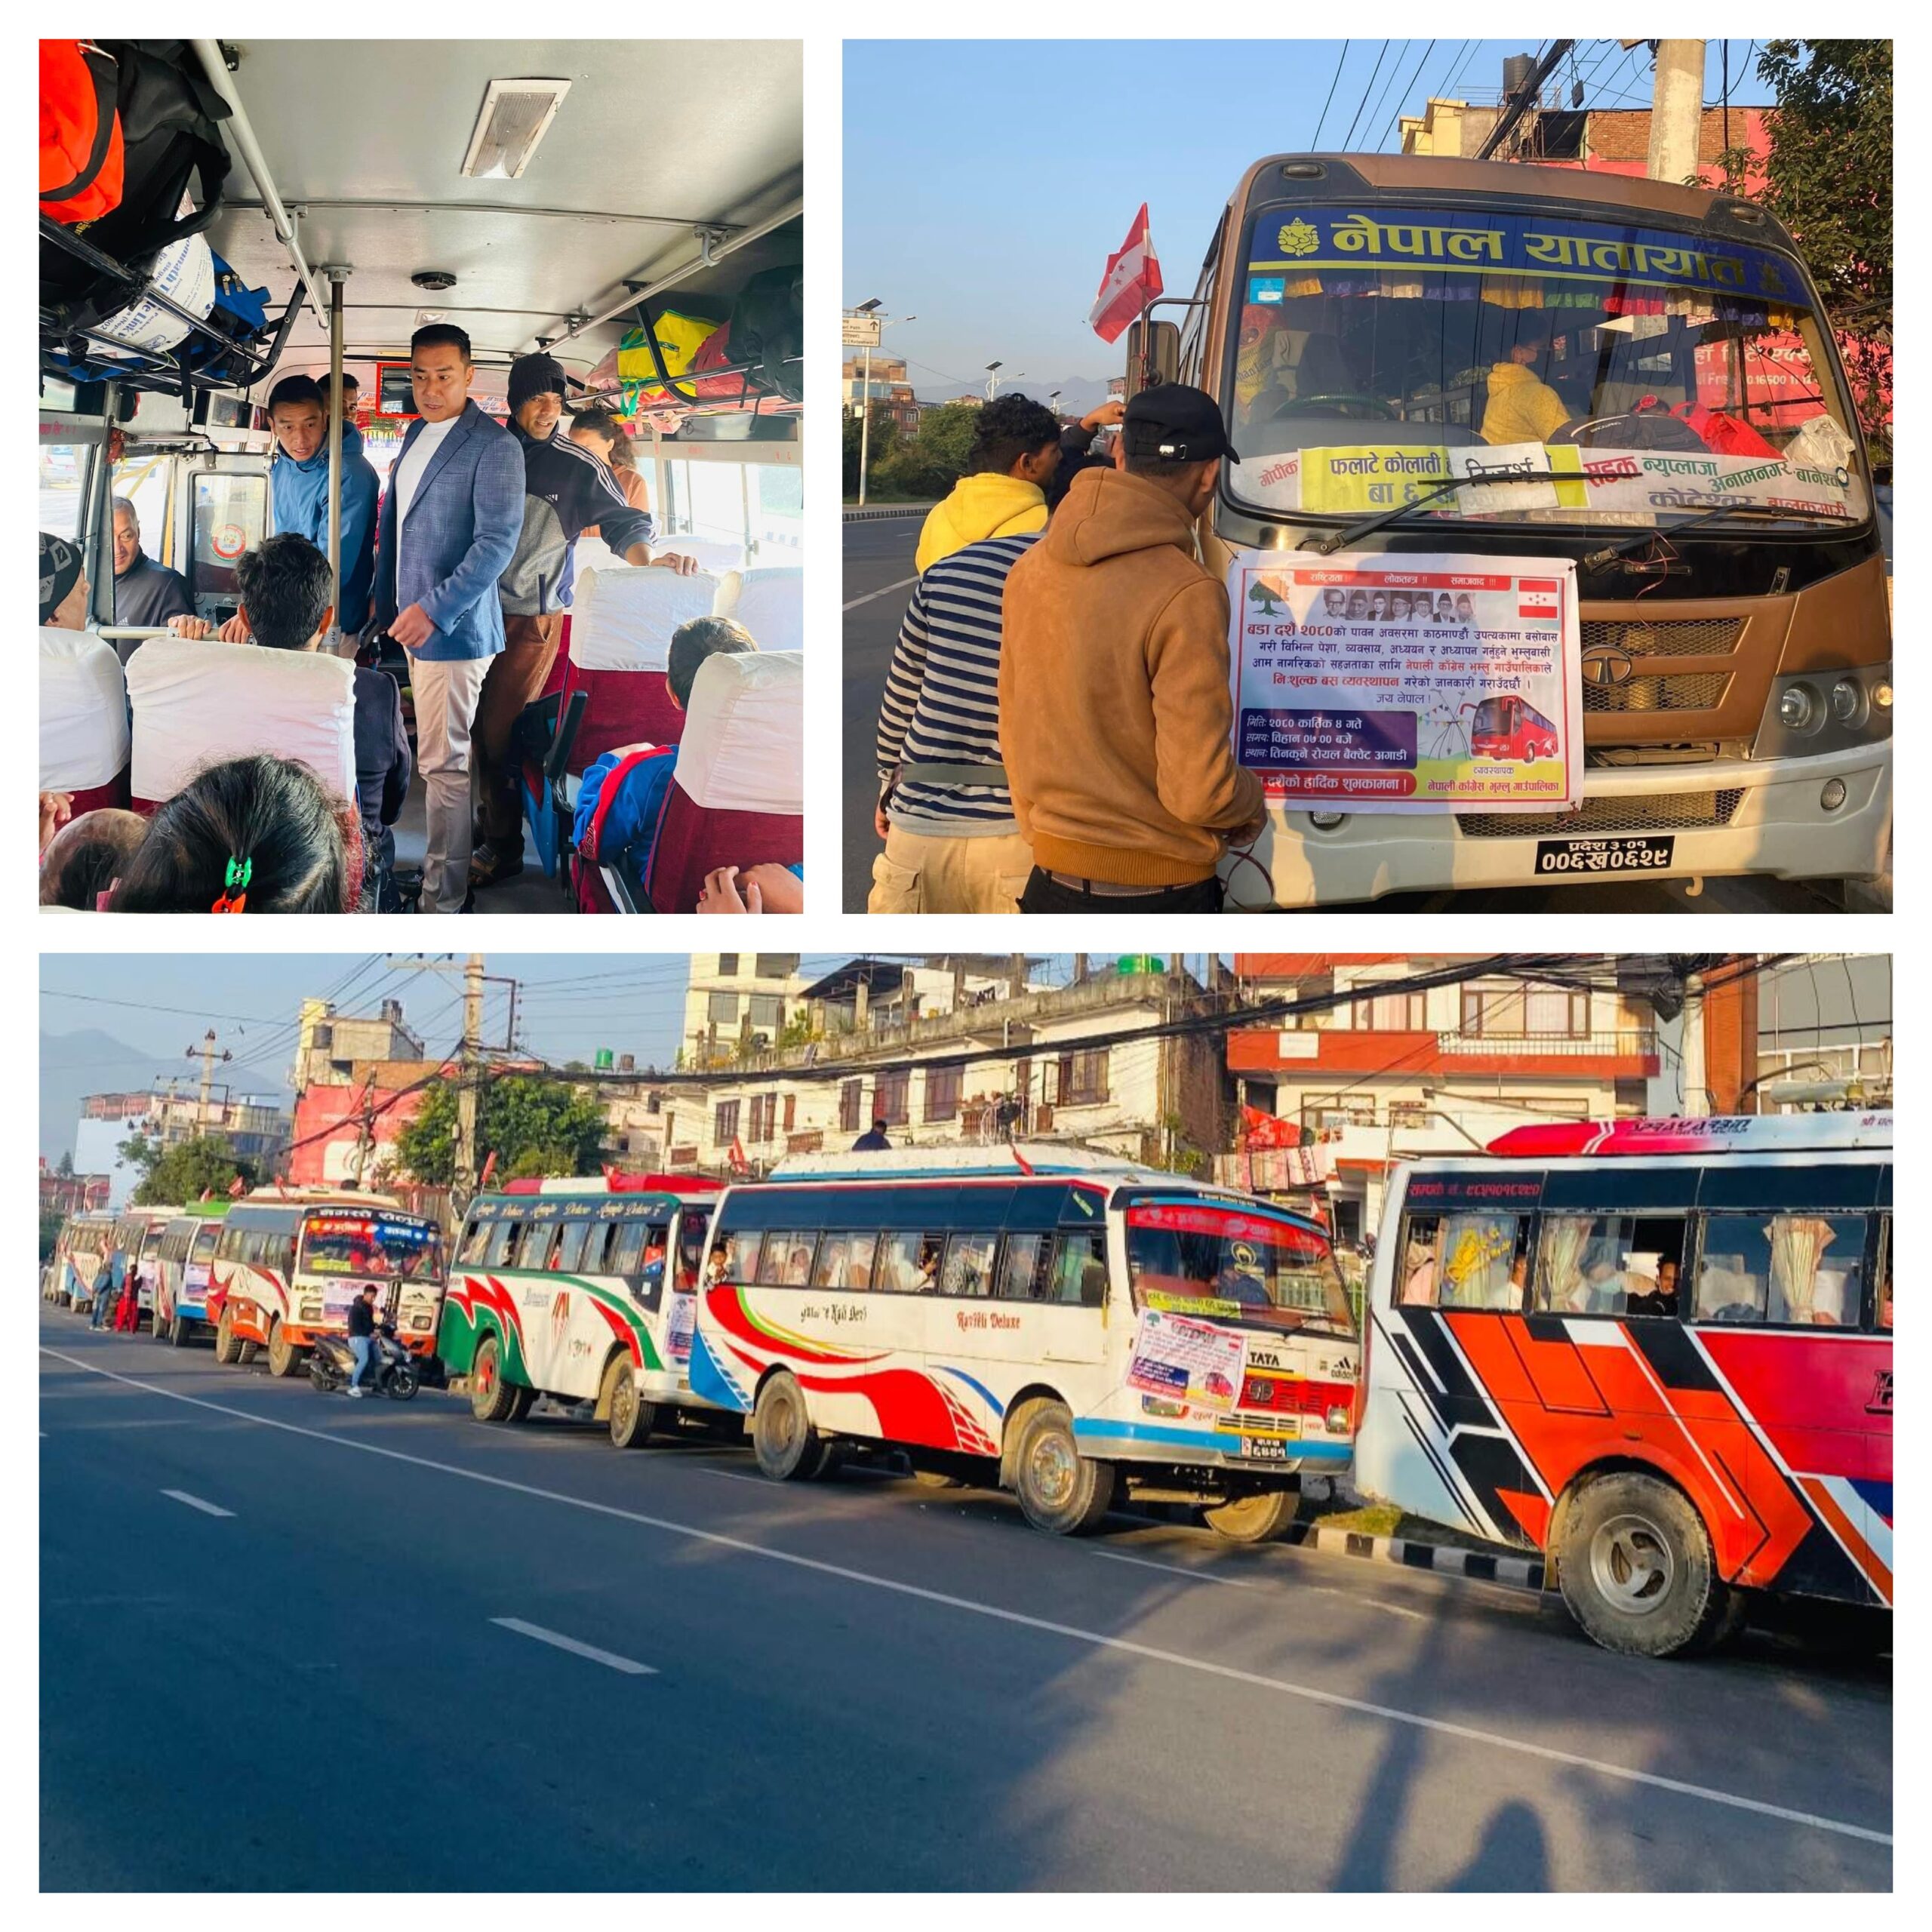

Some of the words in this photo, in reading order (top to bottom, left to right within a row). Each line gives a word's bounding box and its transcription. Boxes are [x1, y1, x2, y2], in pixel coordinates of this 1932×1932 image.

[1331, 214, 1506, 260] नेपाल
[1523, 232, 1746, 286] यातायात
[1330, 452, 1380, 475] फलाटे
[1384, 452, 1442, 475] कोलाती
[1641, 457, 1718, 477] न्युप्लाजा
[1384, 573, 1418, 585] लोकतन्त्र
[1451, 576, 1484, 586] समाजवाद
[1247, 623, 1269, 635] बडा
[1351, 627, 1374, 638] पावन
[1380, 628, 1419, 639] अवसरमा
[1474, 630, 1521, 641] उपत्यकामा
[1259, 640, 1277, 653] गरी
[1281, 639, 1313, 653] विभिन्न
[1390, 645, 1424, 655] अध्ययन
[1430, 647, 1435, 656] र
[1441, 645, 1477, 657] अध्यापन
[1252, 657, 1272, 668] आम
[1277, 656, 1324, 669] नागरिकको
[1330, 660, 1374, 670] सहजताका
[1379, 657, 1402, 670] लागि
[1406, 659, 1433, 671] नेपाली
[1321, 674, 1339, 687] बस
[1342, 675, 1399, 688] व्यवस्थापन
[1404, 675, 1431, 689] गरेको
[1435, 676, 1475, 689] जानकारी
[1376, 693, 1393, 704] जय
[1397, 691, 1425, 704] नेपाल
[1269, 718, 1295, 728] २०८०
[1298, 716, 1333, 729] कार्तिक
[1335, 719, 1342, 730] ४
[1346, 718, 1363, 730] गते
[1335, 733, 1352, 744] बजे
[1311, 748, 1340, 760] रोयल
[1375, 749, 1407, 761] अगाडी
[1303, 774, 1339, 789] हार्दिक
[1343, 777, 1400, 792] शुभकामना
[1428, 780, 1456, 792] नेपाली
[1568, 841, 1607, 852] प्रदेश
[1250, 1352, 1280, 1367] TATA
